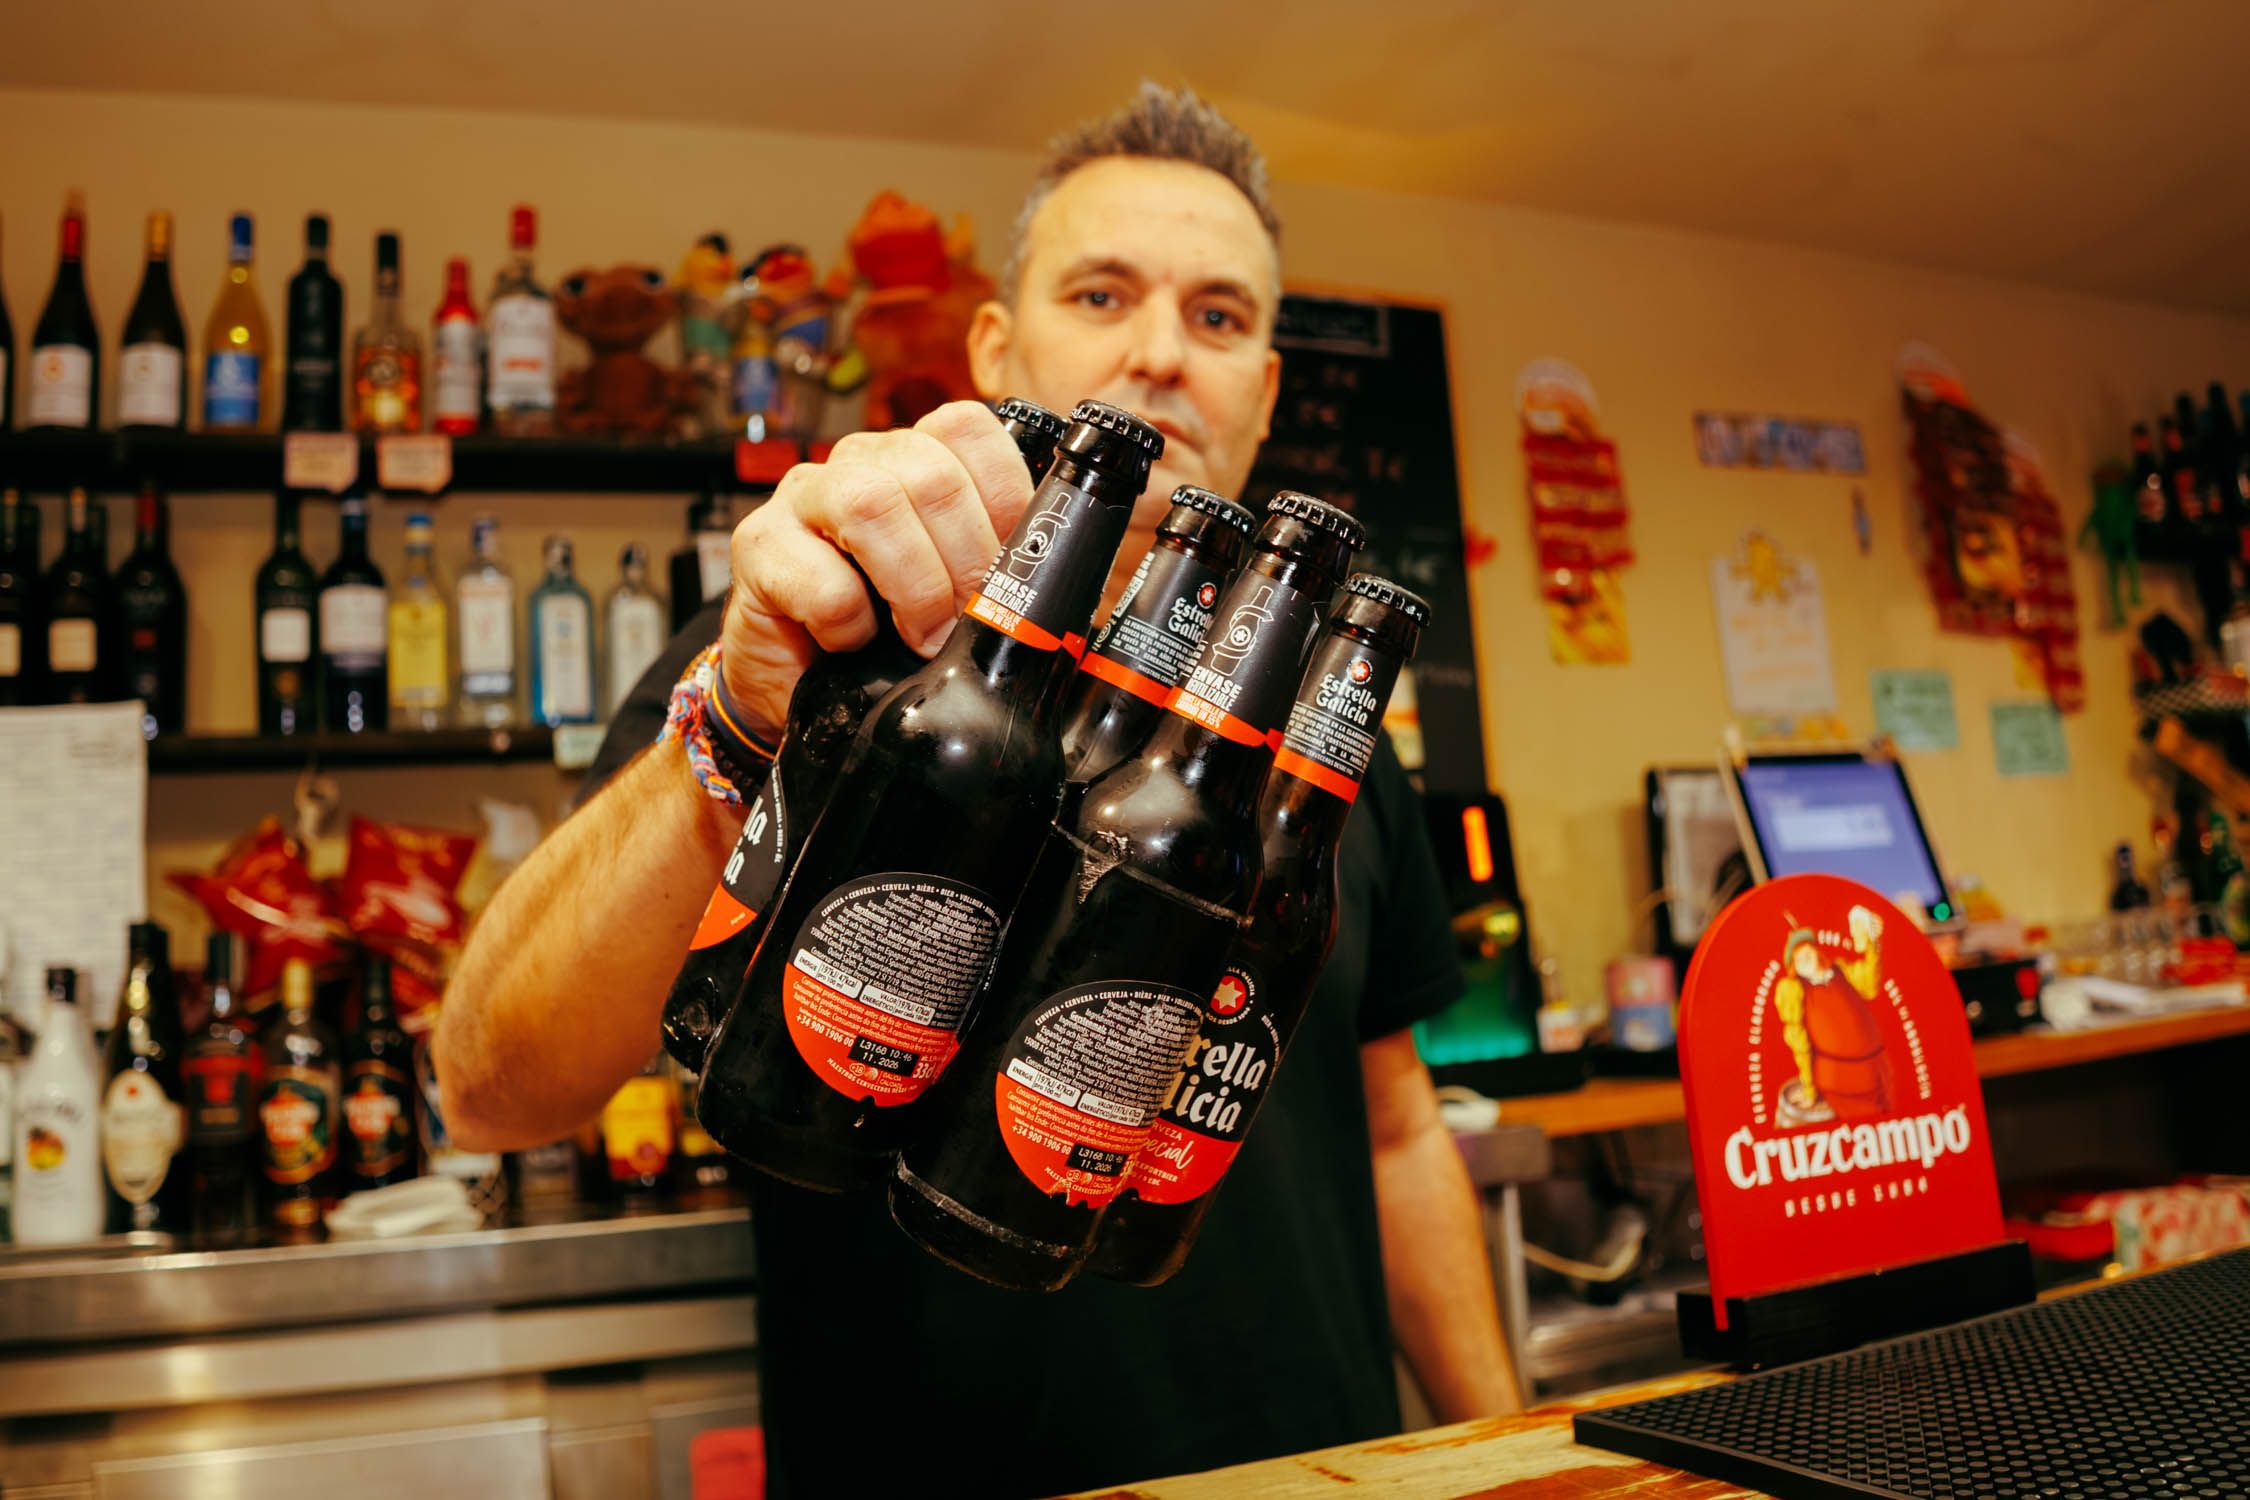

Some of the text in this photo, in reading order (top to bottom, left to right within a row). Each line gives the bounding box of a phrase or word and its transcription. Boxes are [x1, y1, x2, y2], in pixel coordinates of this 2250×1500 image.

[989, 569, 1038, 604] ENVASE
[1168, 614, 1204, 642] Galici
[1170, 596, 1214, 628] Estrell
[1191, 664, 1243, 699] ENVASE
[1320, 672, 1376, 712] Estrella
[1315, 687, 1368, 727] Galicia
[820, 897, 845, 917] CERVEZA
[882, 884, 910, 892] CERVEJA
[916, 883, 935, 893] BIÈRE
[940, 888, 954, 898] BIER
[809, 945, 834, 965] Conservar
[862, 993, 894, 1011] ENERGÉTICO
[879, 992, 897, 1004] VALOR
[1034, 1006, 1061, 1026] CERVEZA
[1100, 992, 1128, 1000] CERVEJA
[1134, 990, 1151, 1000] BIÈRE
[796, 1014, 810, 1030] +34
[810, 1020, 825, 1036] 900
[825, 1028, 843, 1044] 1906
[842, 1035, 854, 1048] 00
[859, 1040, 912, 1062] L3168 10:46
[1185, 1033, 1267, 1091] rella
[826, 1058, 856, 1084] MAESTROS
[1012, 1065, 1032, 1082] ENERGIE
[1162, 1070, 1242, 1133] licia
[1012, 1125, 1072, 1156] +34 900 1906 00
[1151, 1120, 1182, 1142] RVEZA
[1078, 1148, 1104, 1162] L3168
[1143, 1136, 1194, 1170] ecial
